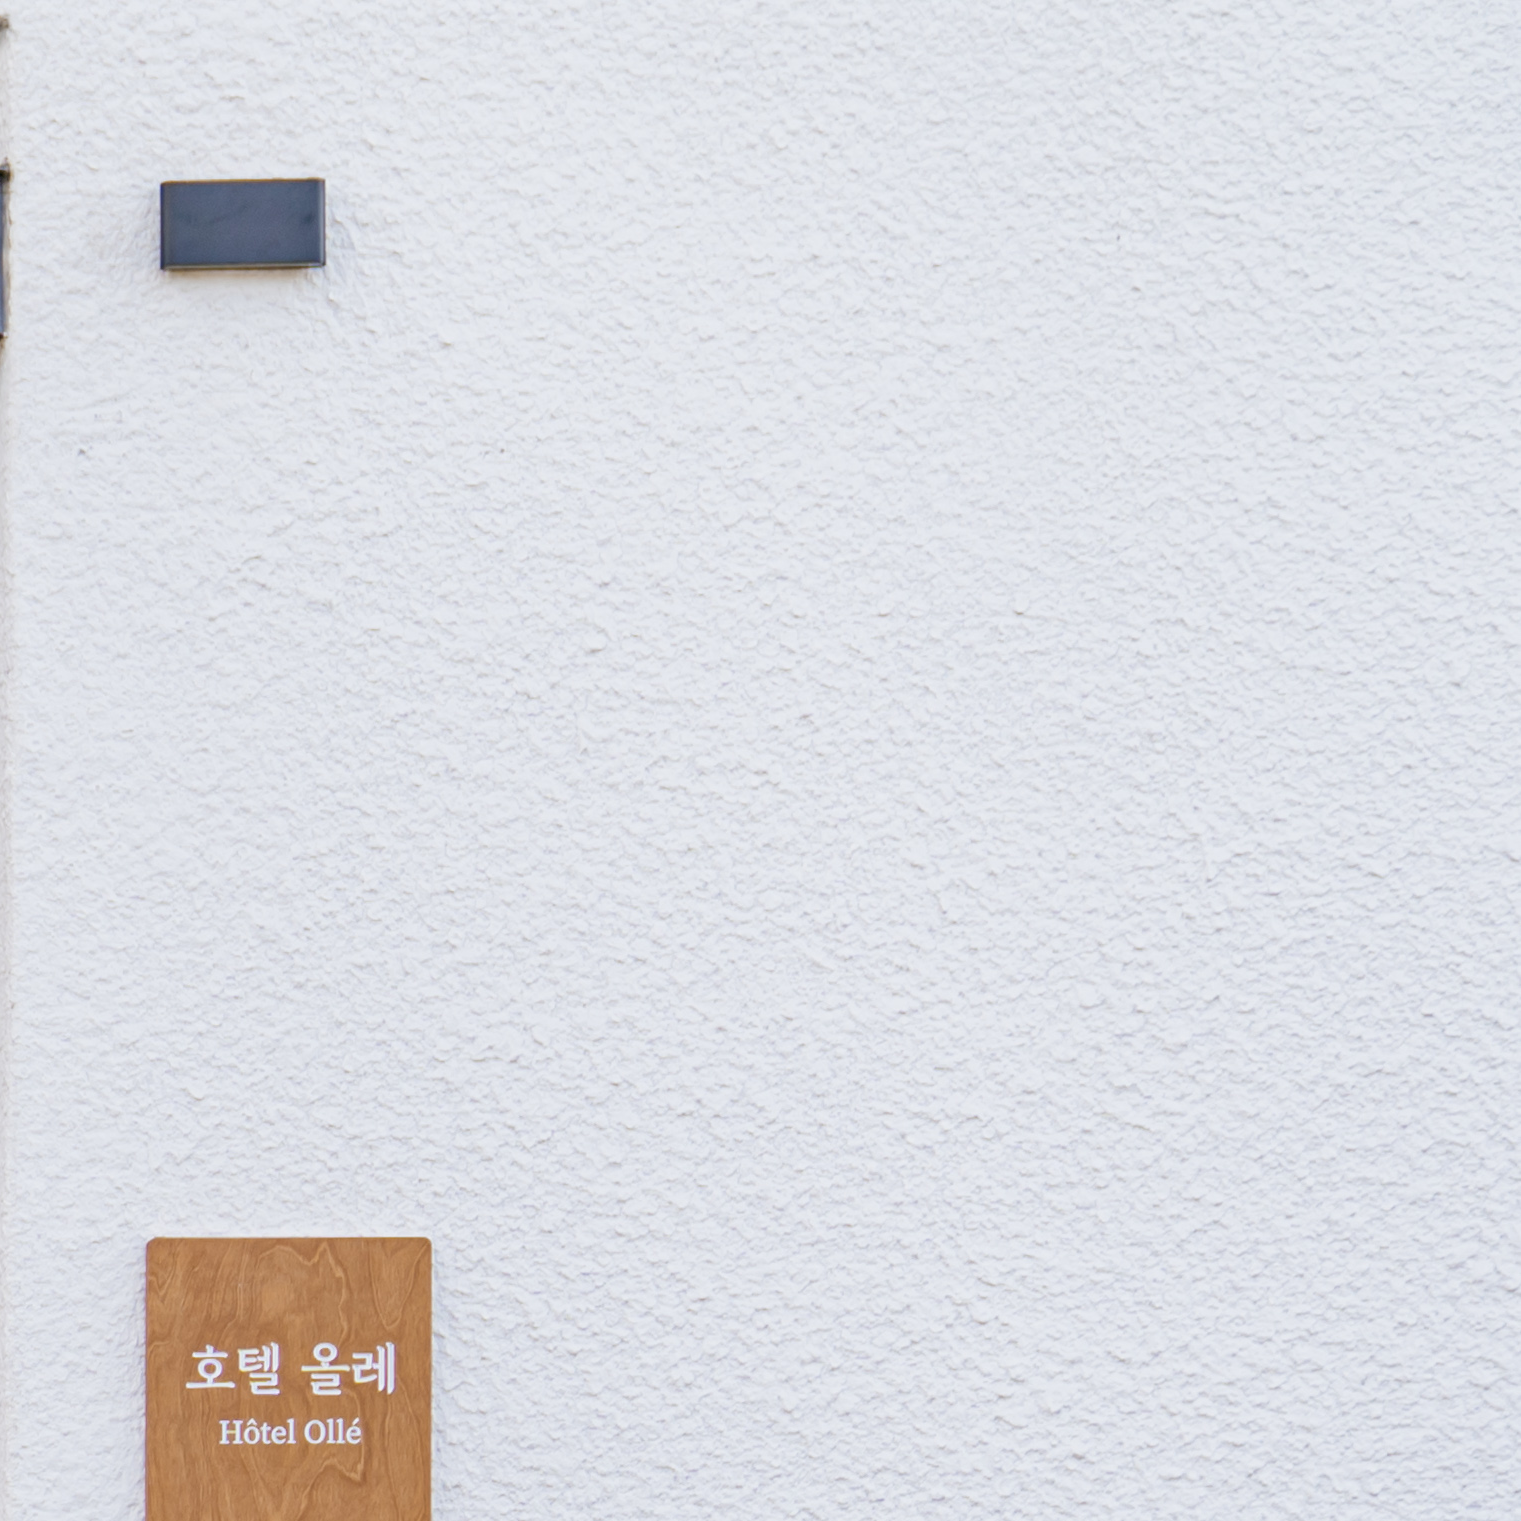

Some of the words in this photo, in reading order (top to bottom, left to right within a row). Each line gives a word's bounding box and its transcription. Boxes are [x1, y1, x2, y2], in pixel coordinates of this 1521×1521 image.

[185, 1342, 281, 1396] 호텔
[300, 1342, 397, 1396] 올레
[218, 1416, 298, 1445] Hôtel
[303, 1416, 362, 1445] Ollé
